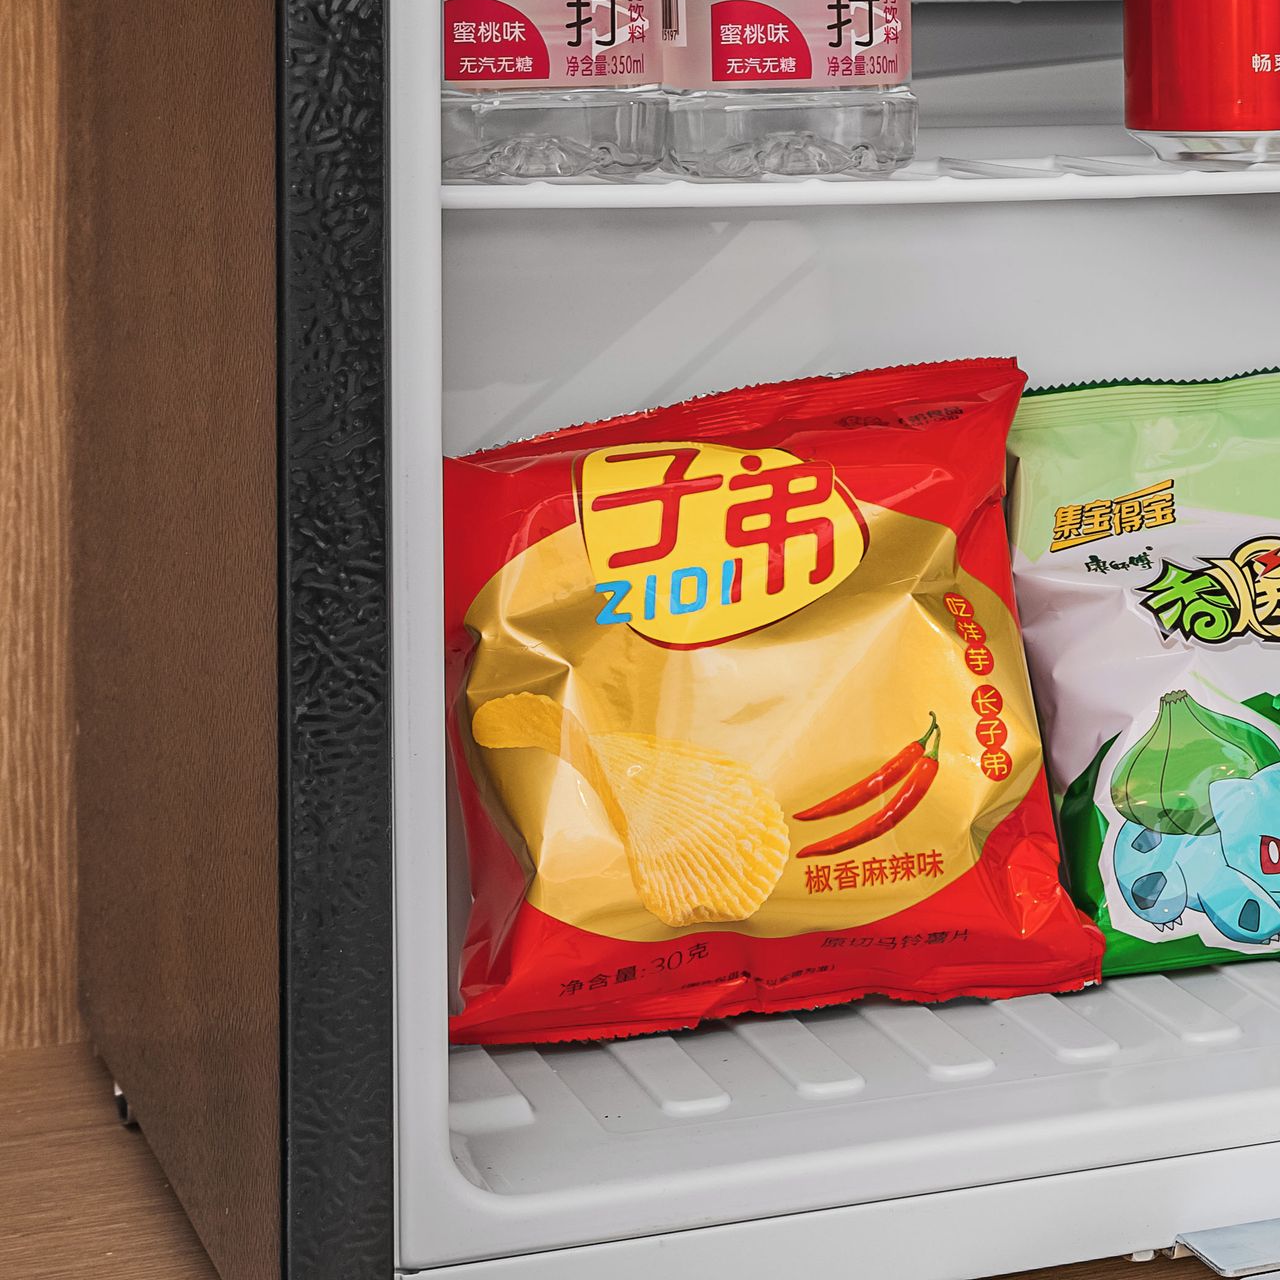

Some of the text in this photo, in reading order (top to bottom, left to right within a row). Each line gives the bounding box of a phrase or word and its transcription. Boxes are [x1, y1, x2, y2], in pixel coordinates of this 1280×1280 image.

[452, 21, 527, 45] 蜜桃味
[719, 22, 790, 46] 蜜桃味
[458, 55, 534, 74] 无汽无糖
[725, 56, 797, 75] 无汽无糖
[590, 447, 836, 596] 子弟
[1052, 492, 1177, 541] 集宝得宝
[944, 596, 1009, 777] 吃洋芋 长子弟
[804, 848, 945, 895] 椒香麻辣味
[820, 928, 970, 950] 原切马铃薯片
